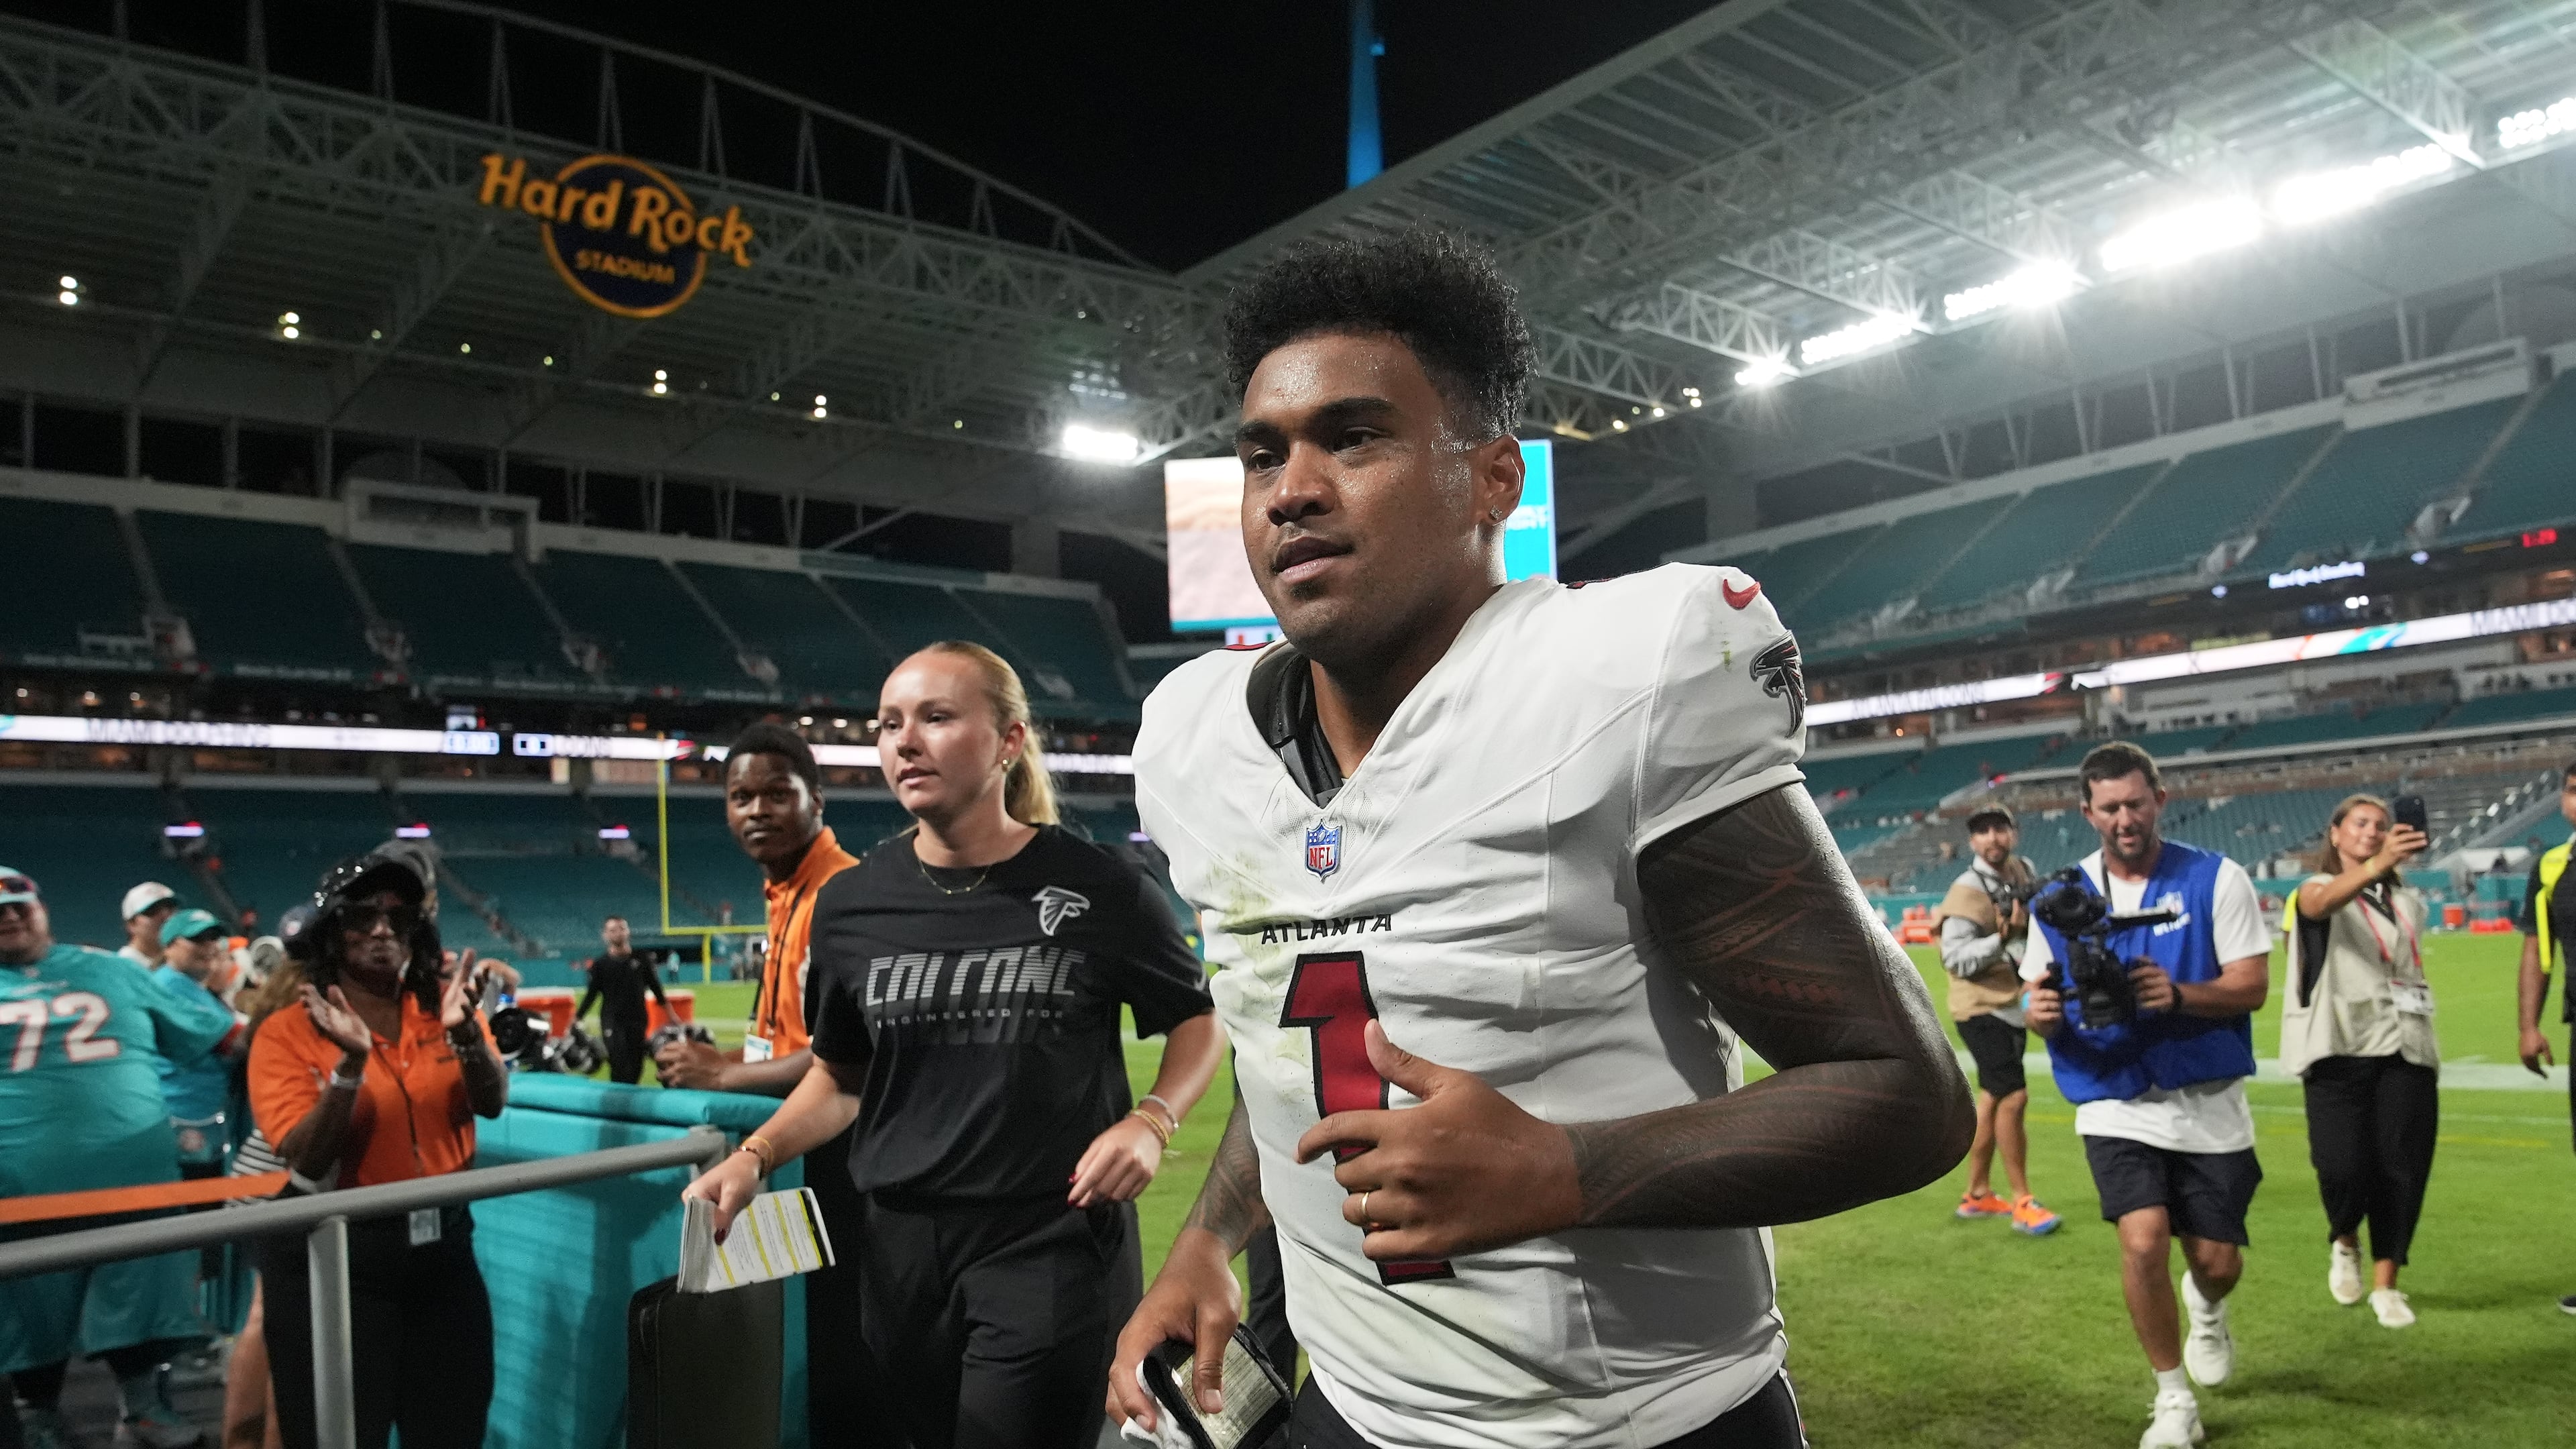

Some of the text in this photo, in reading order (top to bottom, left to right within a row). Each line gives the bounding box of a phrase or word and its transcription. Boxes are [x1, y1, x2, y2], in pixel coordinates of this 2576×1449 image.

[480, 154, 753, 266] Hard Rock
[576, 250, 675, 284] STADIUM
[1309, 846, 1334, 870] NFL
[1261, 913, 1392, 945] ATLANTA
[0, 991, 121, 1073] 72
[1279, 949, 1456, 1286] 1
